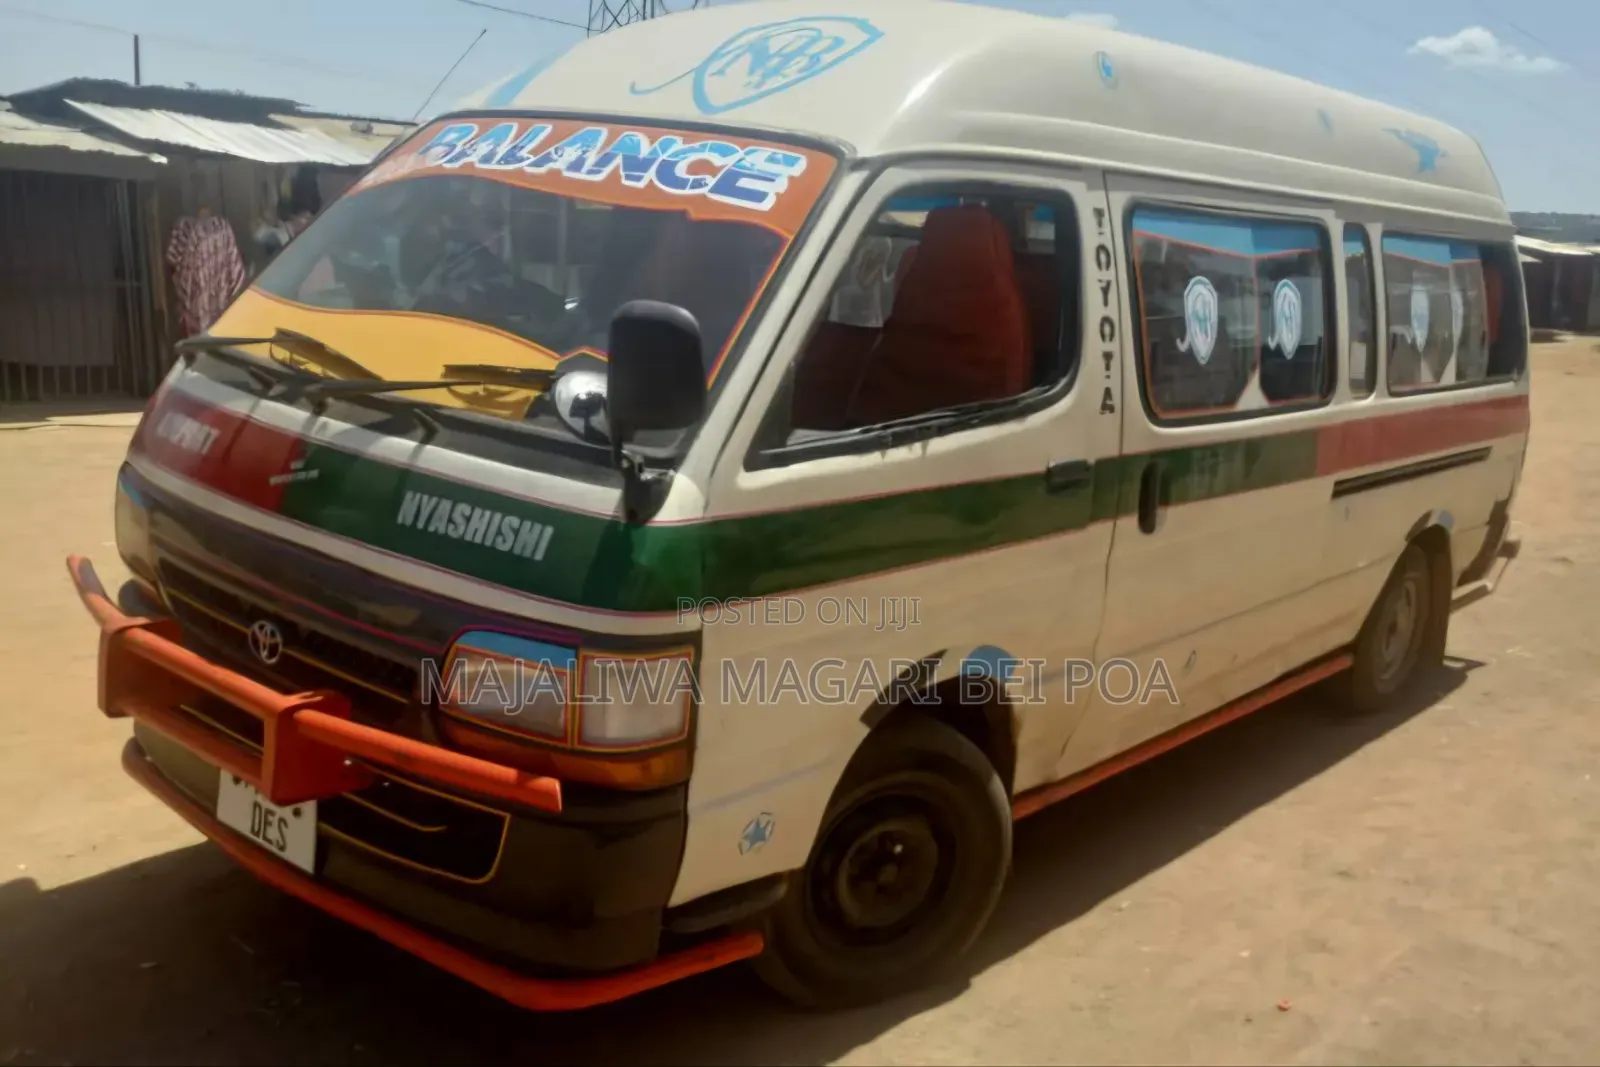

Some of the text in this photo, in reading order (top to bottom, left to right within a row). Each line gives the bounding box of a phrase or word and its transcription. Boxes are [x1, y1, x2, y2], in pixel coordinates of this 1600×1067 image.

[417, 122, 807, 211] BALANCE
[1093, 207, 1115, 415] TOYOTA
[396, 490, 554, 561] NYASHISHI
[250, 801, 289, 853] DES
